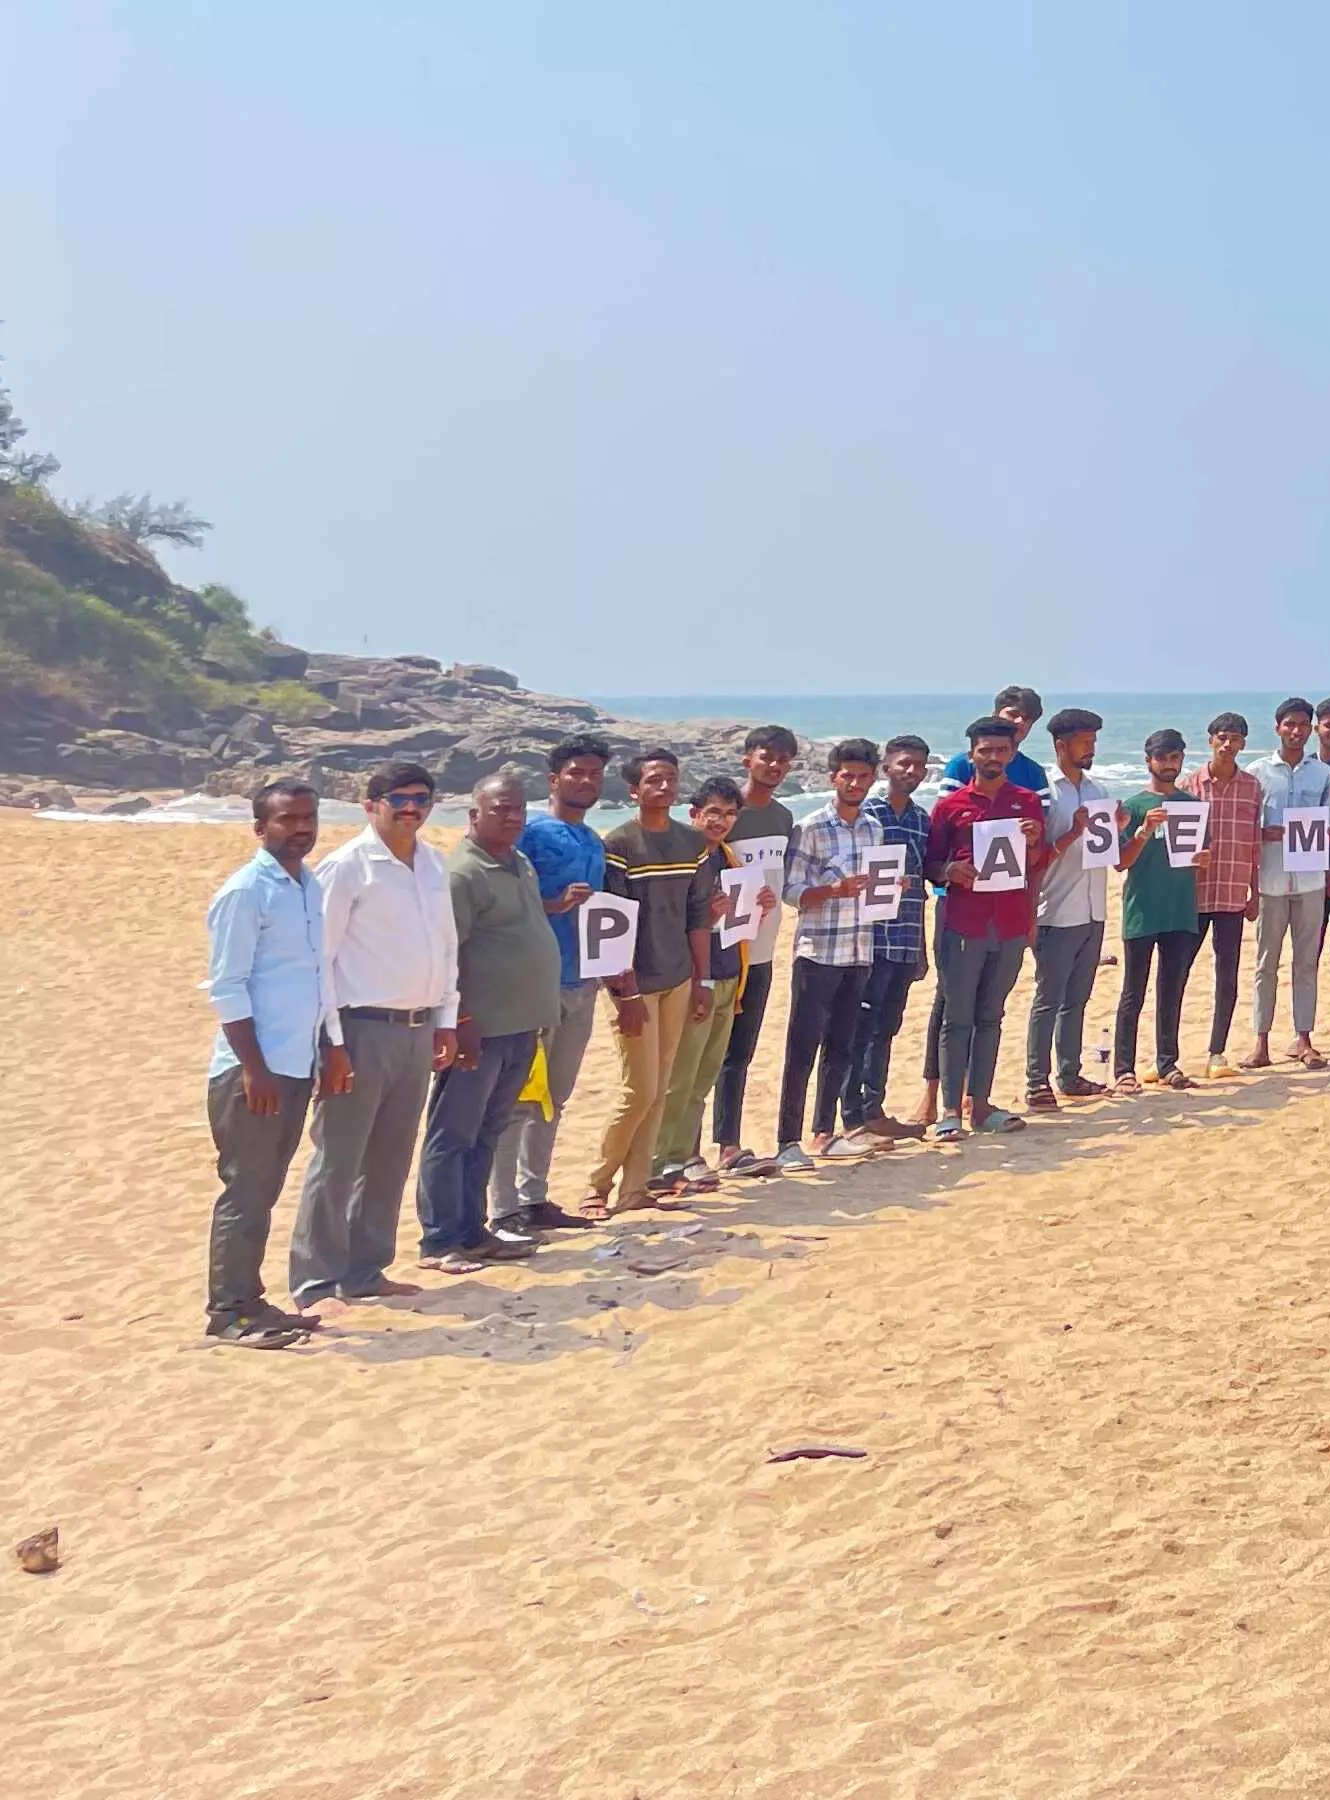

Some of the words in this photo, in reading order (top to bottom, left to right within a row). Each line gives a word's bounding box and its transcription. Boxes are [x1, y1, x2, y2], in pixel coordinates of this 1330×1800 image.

[1087, 811, 1113, 854] S
[1167, 814, 1201, 853] E
[1288, 819, 1326, 853] M
[977, 836, 1023, 881] A
[865, 860, 899, 906] E
[724, 884, 752, 931] L
[587, 908, 630, 960] P
